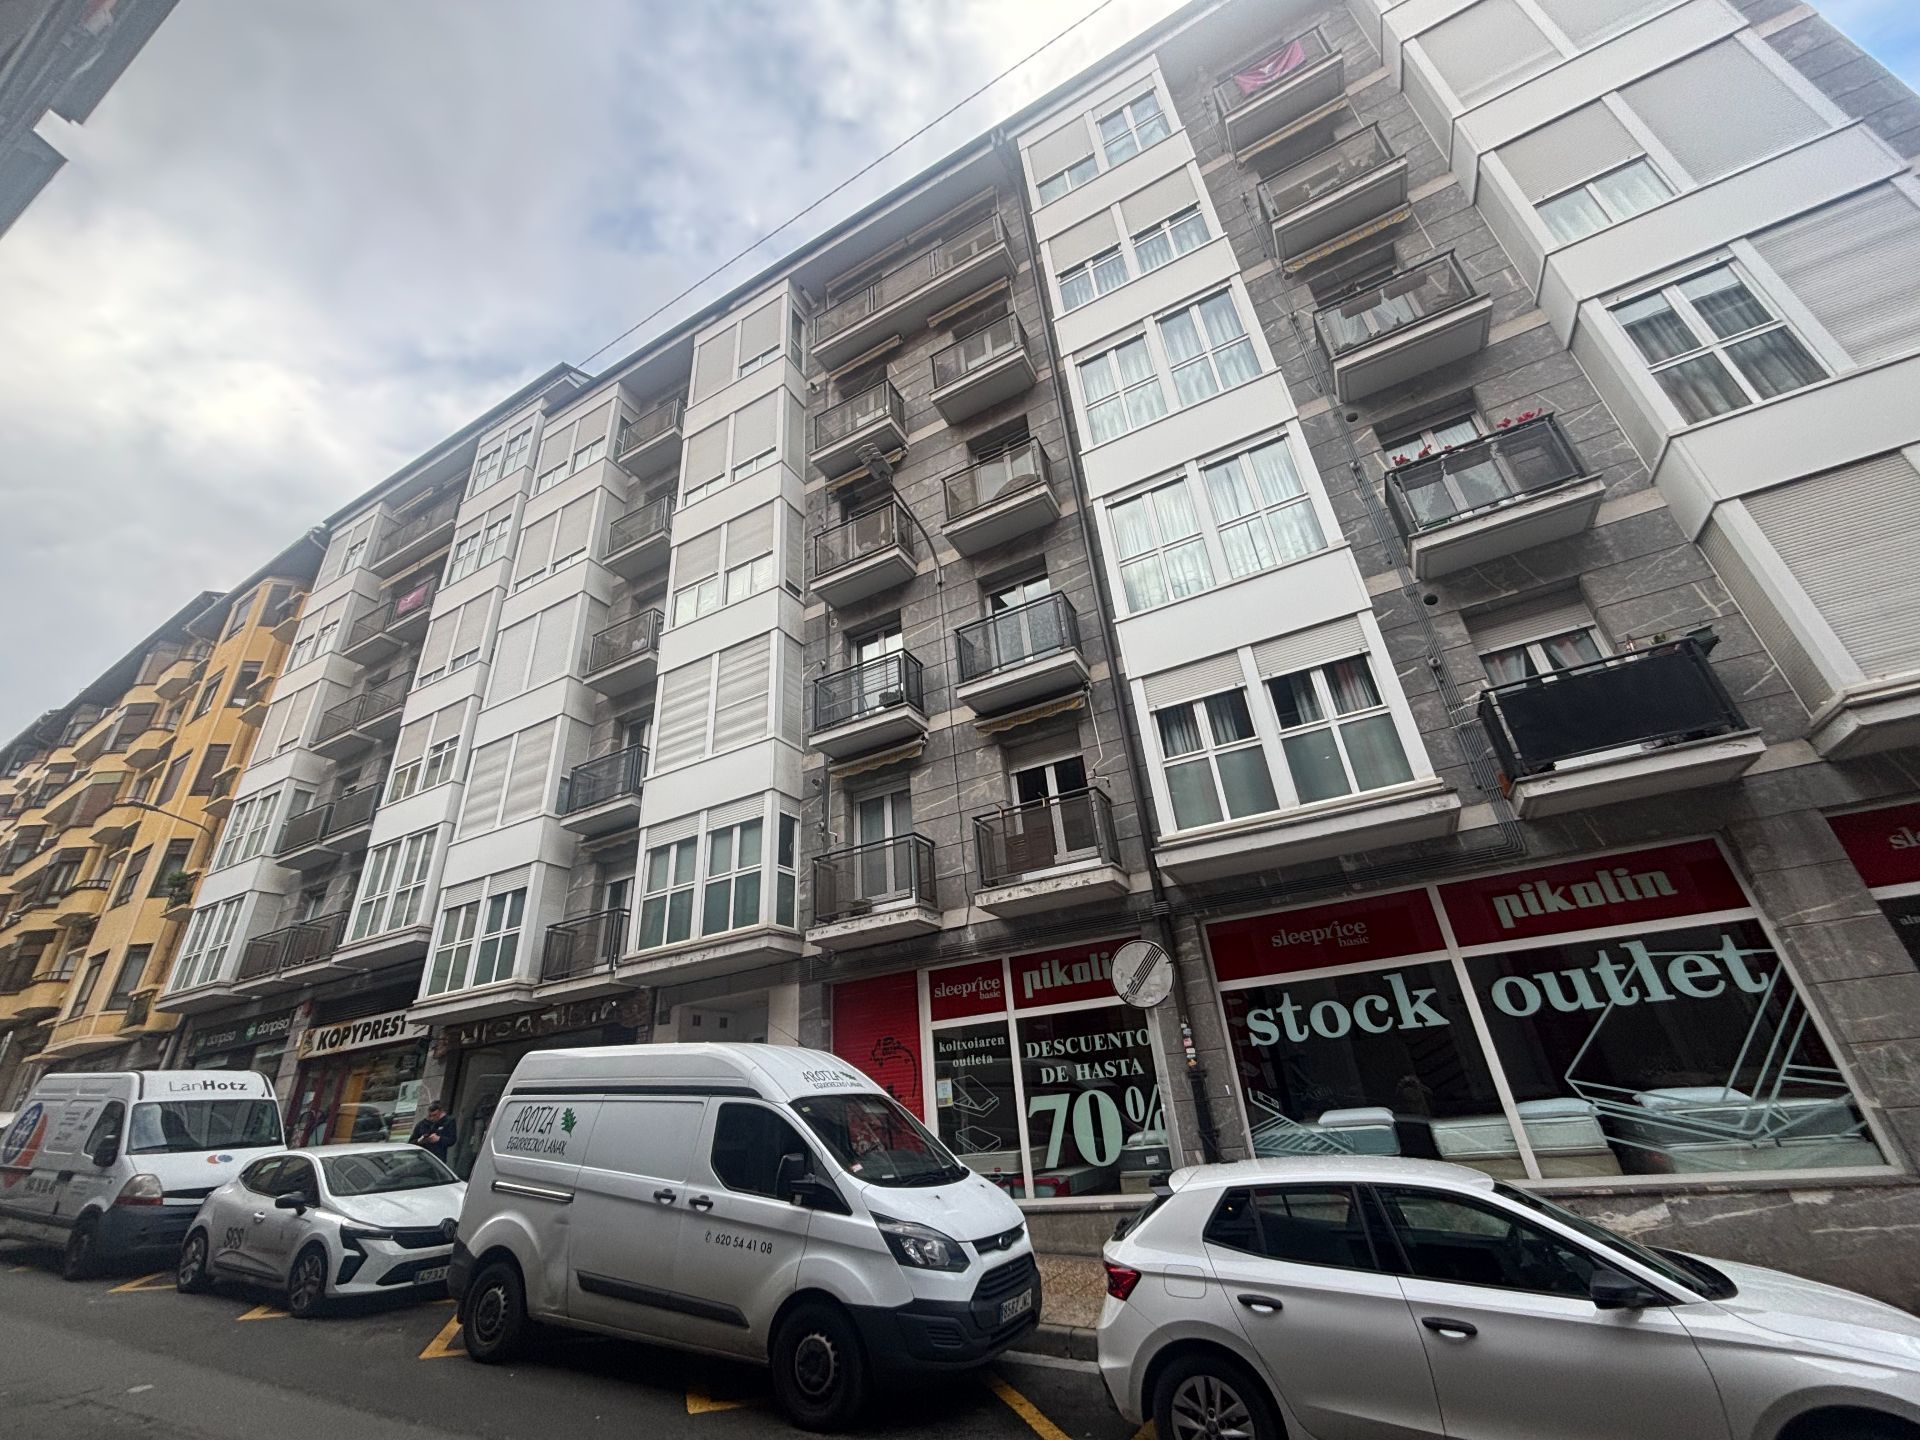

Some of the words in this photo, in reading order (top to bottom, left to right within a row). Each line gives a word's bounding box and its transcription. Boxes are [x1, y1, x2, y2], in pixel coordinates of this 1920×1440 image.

[1492, 867, 1678, 929] pikolin
[1271, 921, 1367, 947] sleeprice
[1338, 934, 1369, 947] basic
[934, 976, 1001, 998] sleeprice
[1022, 952, 1113, 999] pikoli
[979, 990, 1001, 1000] basic
[1246, 973, 1450, 1047] stock
[1491, 934, 1770, 1017] outlet
[316, 1014, 407, 1051] KOPYPREST
[938, 1034, 1005, 1053] koltxoiaren
[1025, 1028, 1152, 1059] DESCUENTO
[952, 1053, 994, 1068] outleta
[1041, 1065, 1069, 1084] DE
[1075, 1058, 1145, 1080] HASTA
[169, 1080, 248, 1092] LanHotz
[802, 1070, 842, 1083] AROTZA
[510, 1105, 560, 1134] AROTZA
[715, 1234, 732, 1246] 620
[732, 1236, 745, 1248] 54
[746, 1239, 757, 1252] 41
[760, 1241, 773, 1254] 08
